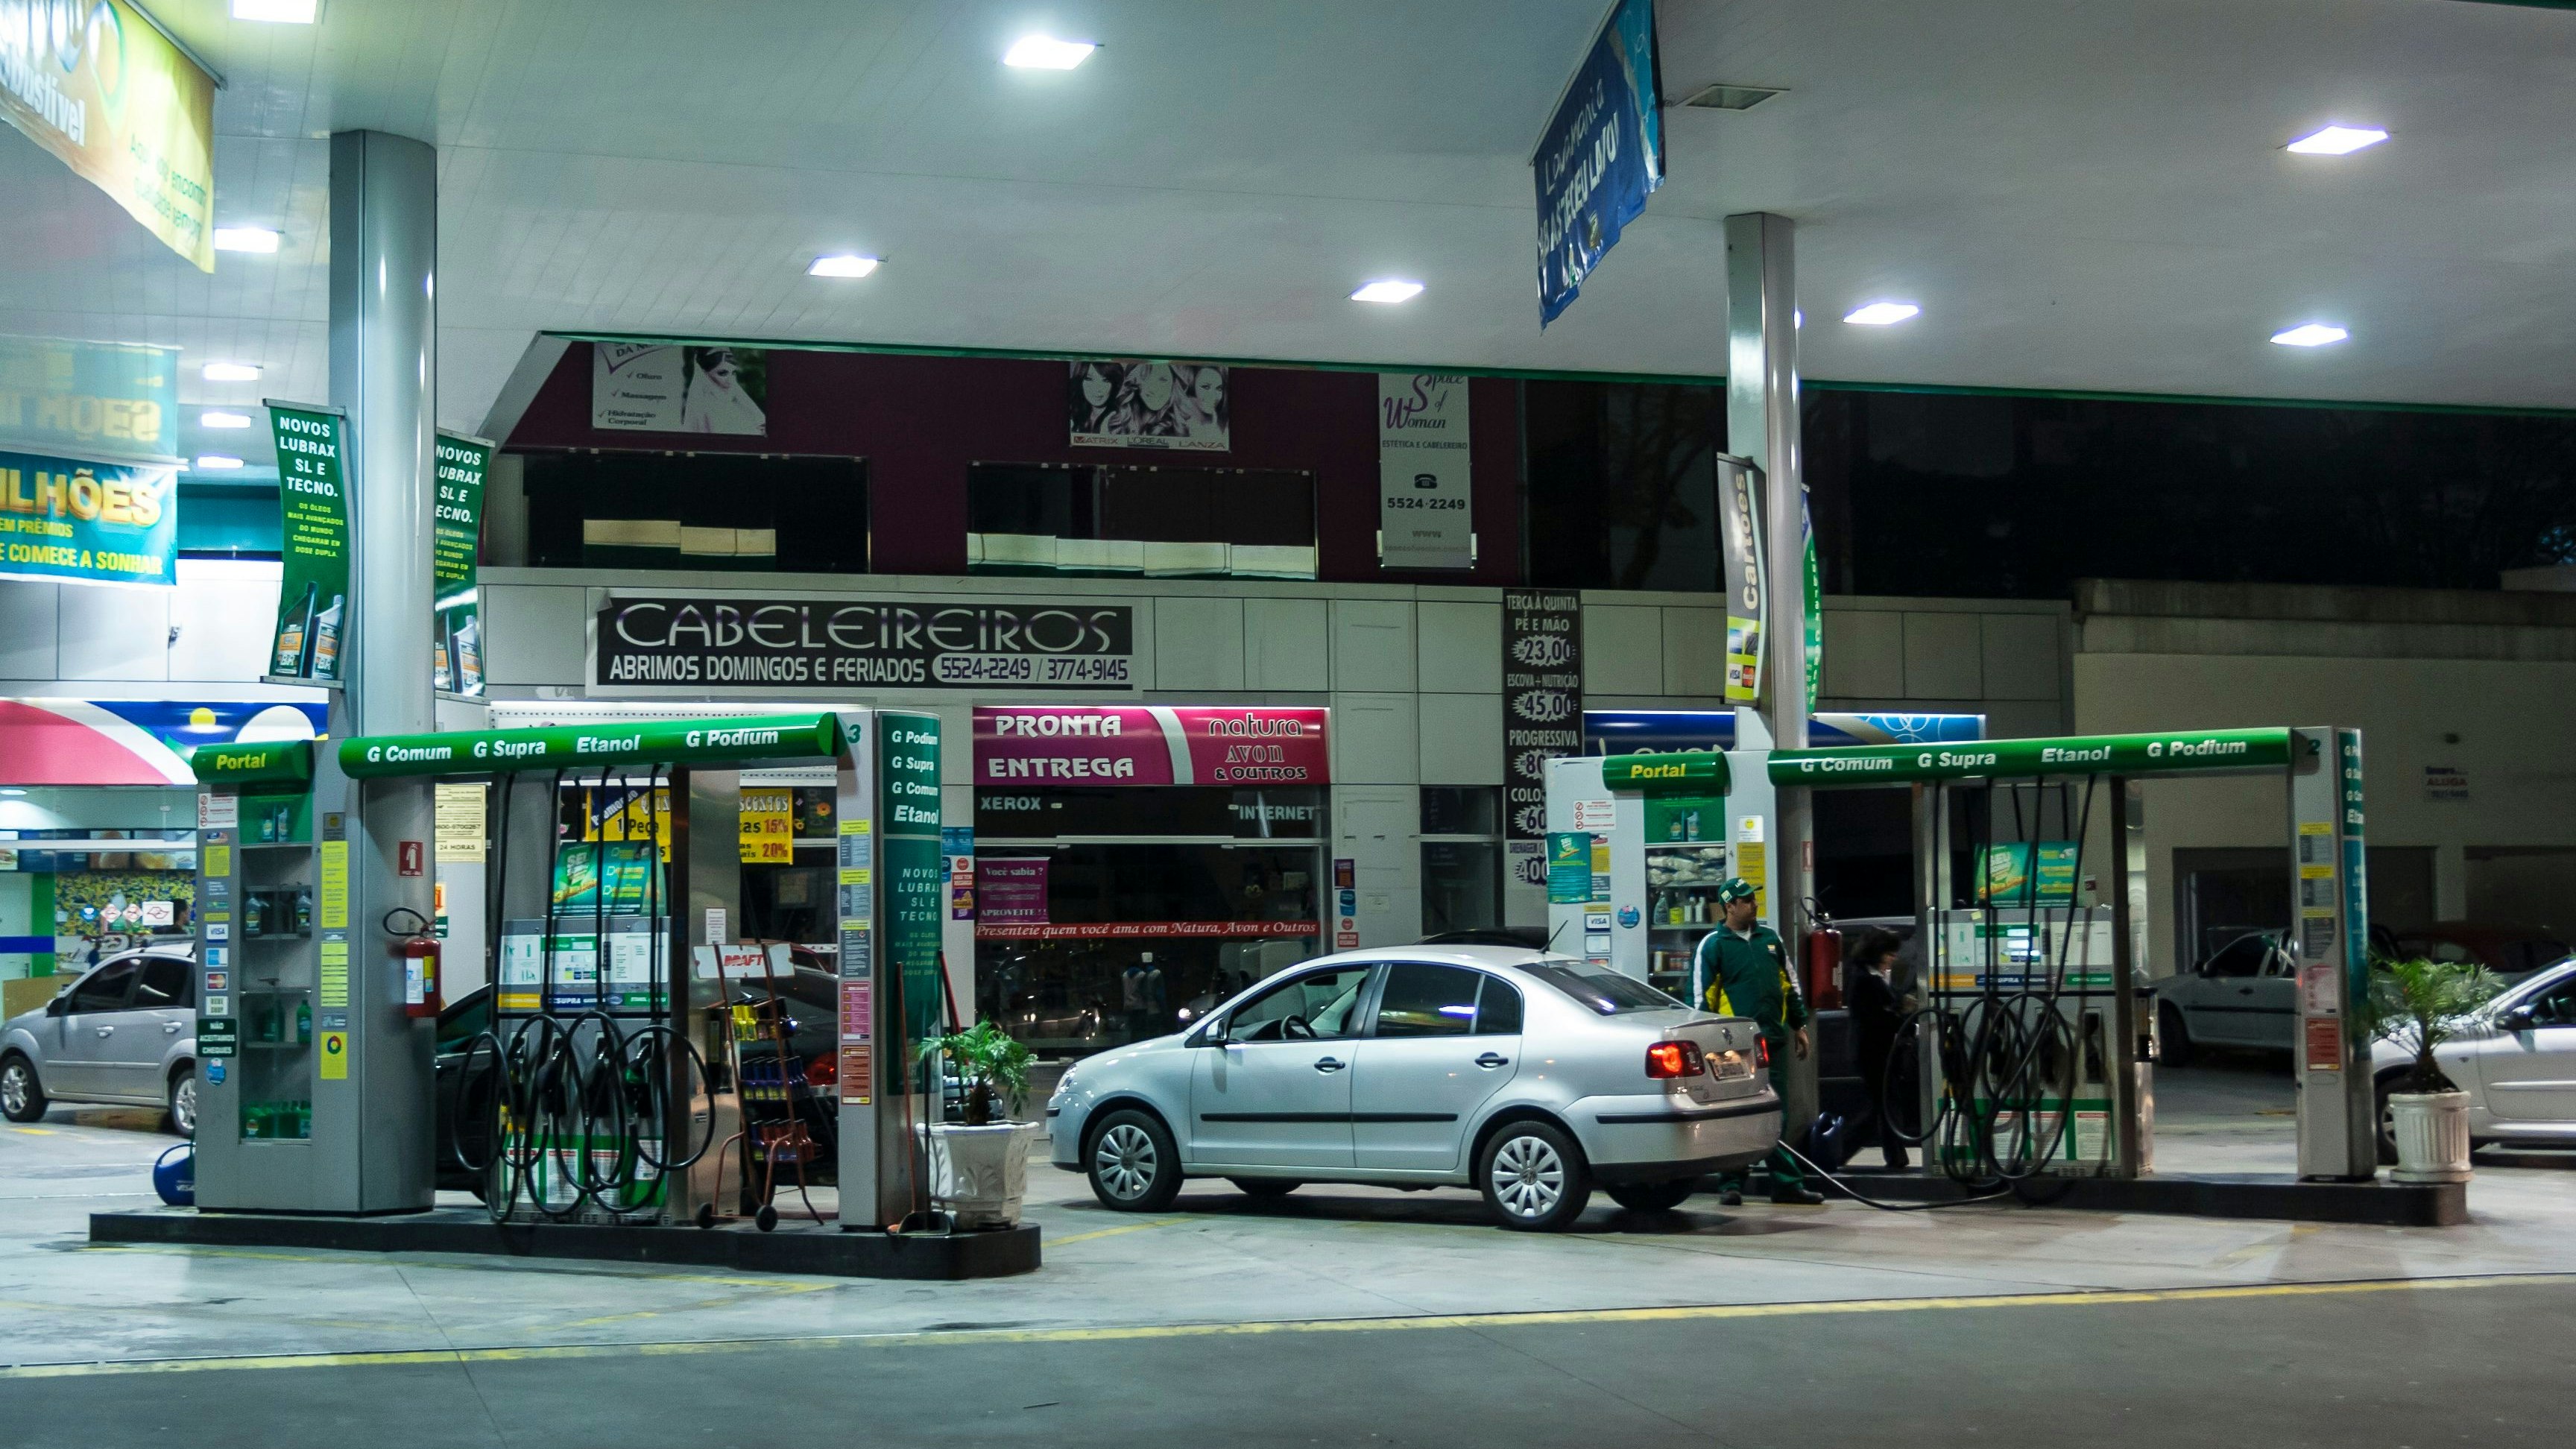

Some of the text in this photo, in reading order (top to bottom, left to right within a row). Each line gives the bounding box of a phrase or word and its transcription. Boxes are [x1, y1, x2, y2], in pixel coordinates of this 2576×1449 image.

[1383, 396, 1446, 429] Woman
[280, 416, 330, 438] NOVOS
[280, 436, 335, 458] LUBRAX
[435, 445, 482, 465] NOVOS
[295, 458, 326, 476] SL E
[438, 465, 482, 485] UBRAX
[286, 476, 338, 497] TECNO.
[440, 485, 468, 502] SL E
[0, 467, 162, 526] ILHÕES
[435, 504, 473, 523] ECNO.
[18, 517, 73, 538] PRÊMIOS
[9, 543, 78, 567] COMECE
[80, 550, 92, 569] A
[96, 552, 163, 575] SONHAR
[1543, 596, 1577, 612] QUINTA
[616, 602, 1118, 653] CABELEIREIROS
[1532, 618, 1538, 631] E
[1542, 616, 1570, 632] MÃO
[1524, 640, 1573, 664] 23,00
[609, 655, 700, 681] ABRIMOS
[706, 656, 808, 681] DOMINGOS
[814, 658, 827, 681] E
[833, 658, 926, 682] FERIADOS
[939, 657, 1032, 681] 5524-2249
[1047, 658, 1128, 681] 3774-9145
[1524, 695, 1573, 719] 45,00
[847, 724, 861, 744] 3
[995, 714, 1122, 738] PRONTA
[1209, 713, 1303, 738] natura
[576, 734, 640, 754] Etanol
[686, 730, 779, 748] G Podium
[892, 730, 938, 745] G Podium
[1509, 730, 1579, 746] PROGRESSIVA
[367, 744, 452, 763] G Comum
[473, 740, 546, 759] G Supra
[2041, 746, 2111, 763] Etanol
[2147, 739, 2247, 758] G Podium
[215, 752, 267, 770] Portal
[892, 756, 935, 771] G Supra
[988, 757, 1134, 779] ENTREGA
[1801, 756, 1892, 773] G Comum
[1918, 751, 1996, 769] G Supra
[1215, 767, 1307, 780] & OUTROS
[1630, 763, 1687, 779] Portal
[892, 782, 938, 797] G Comum
[981, 797, 1041, 811] XEROX
[894, 805, 939, 824] Etanol
[1239, 806, 1315, 821] INTERNET
[764, 818, 789, 833] 15%
[763, 843, 788, 858] 20%
[1010, 867, 1035, 876] sabia
[911, 897, 925, 908] SL
[980, 909, 1035, 917] APROVEITE
[1042, 926, 1076, 938] quem
[1081, 923, 1110, 935] você
[1112, 926, 1139, 934] ama
[1143, 924, 1167, 934] com
[1170, 923, 1221, 935] Natura,
[1222, 923, 1259, 934] Avon
[1263, 924, 1270, 933] e
[1272, 921, 1316, 934] Outros
[724, 954, 763, 967] DRAFT
